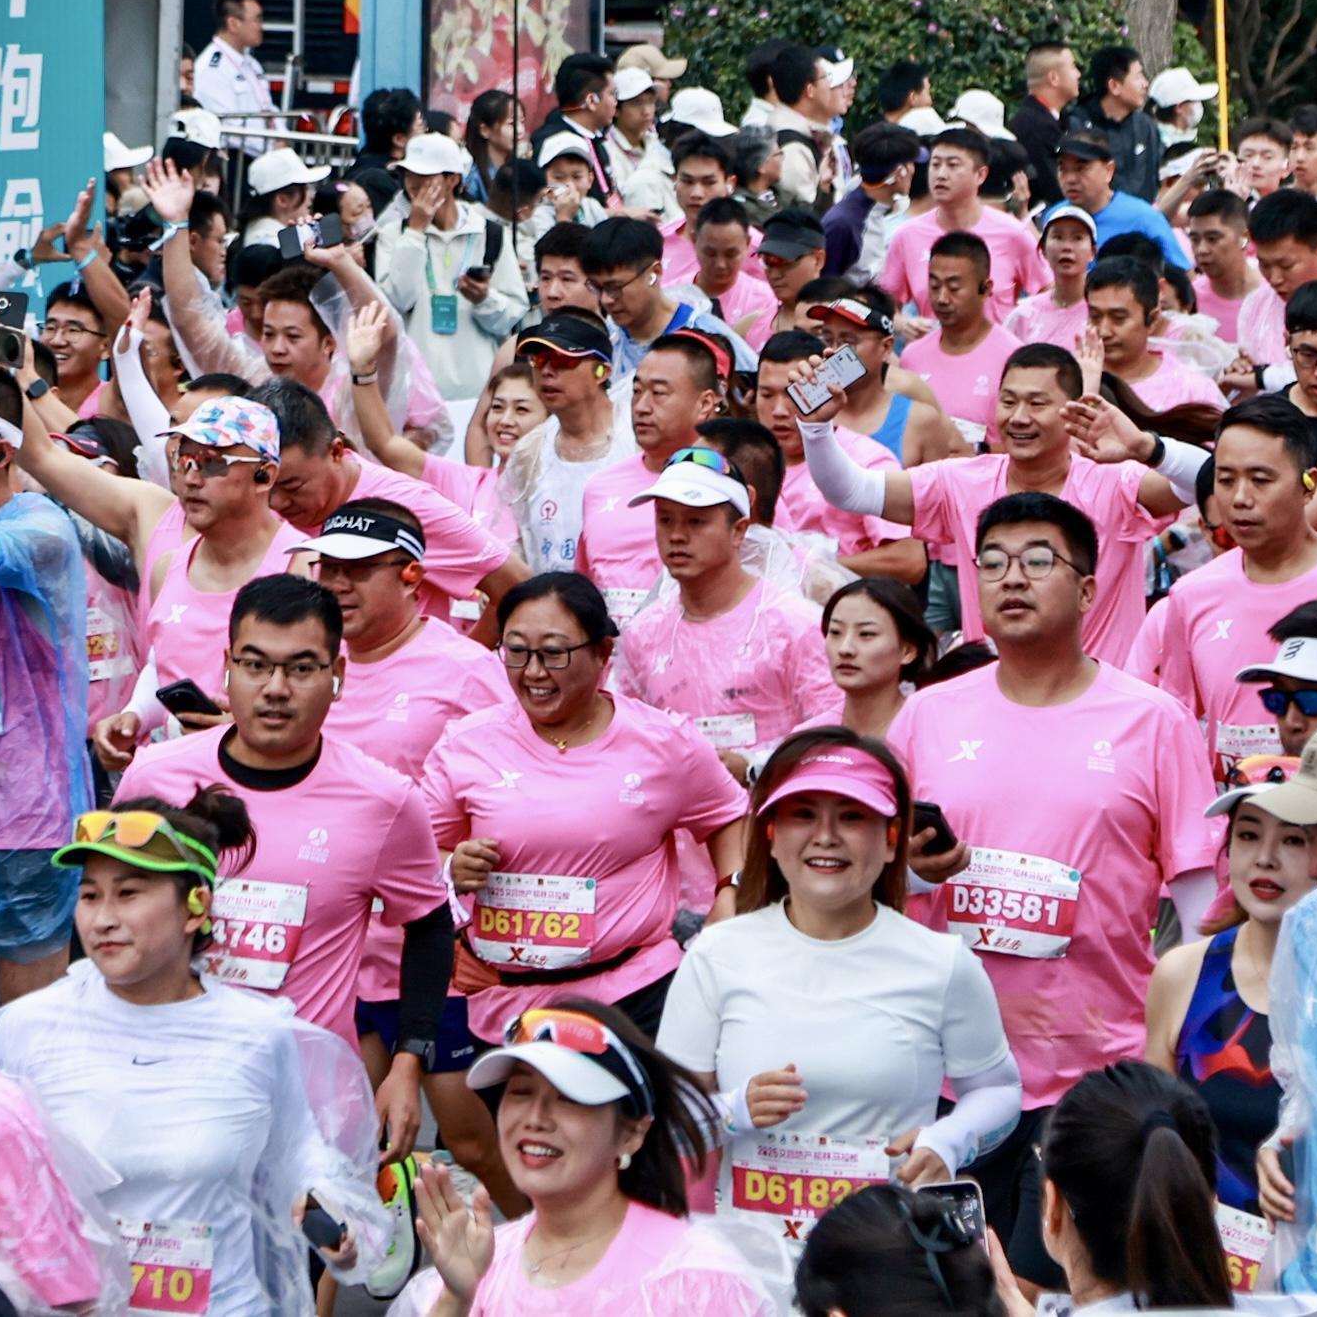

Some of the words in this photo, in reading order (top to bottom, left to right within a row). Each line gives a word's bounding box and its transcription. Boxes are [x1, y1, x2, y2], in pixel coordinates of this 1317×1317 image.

[480, 907, 582, 940] D61762
[953, 882, 1062, 927] D33581
[744, 1170, 871, 1210] D6182
